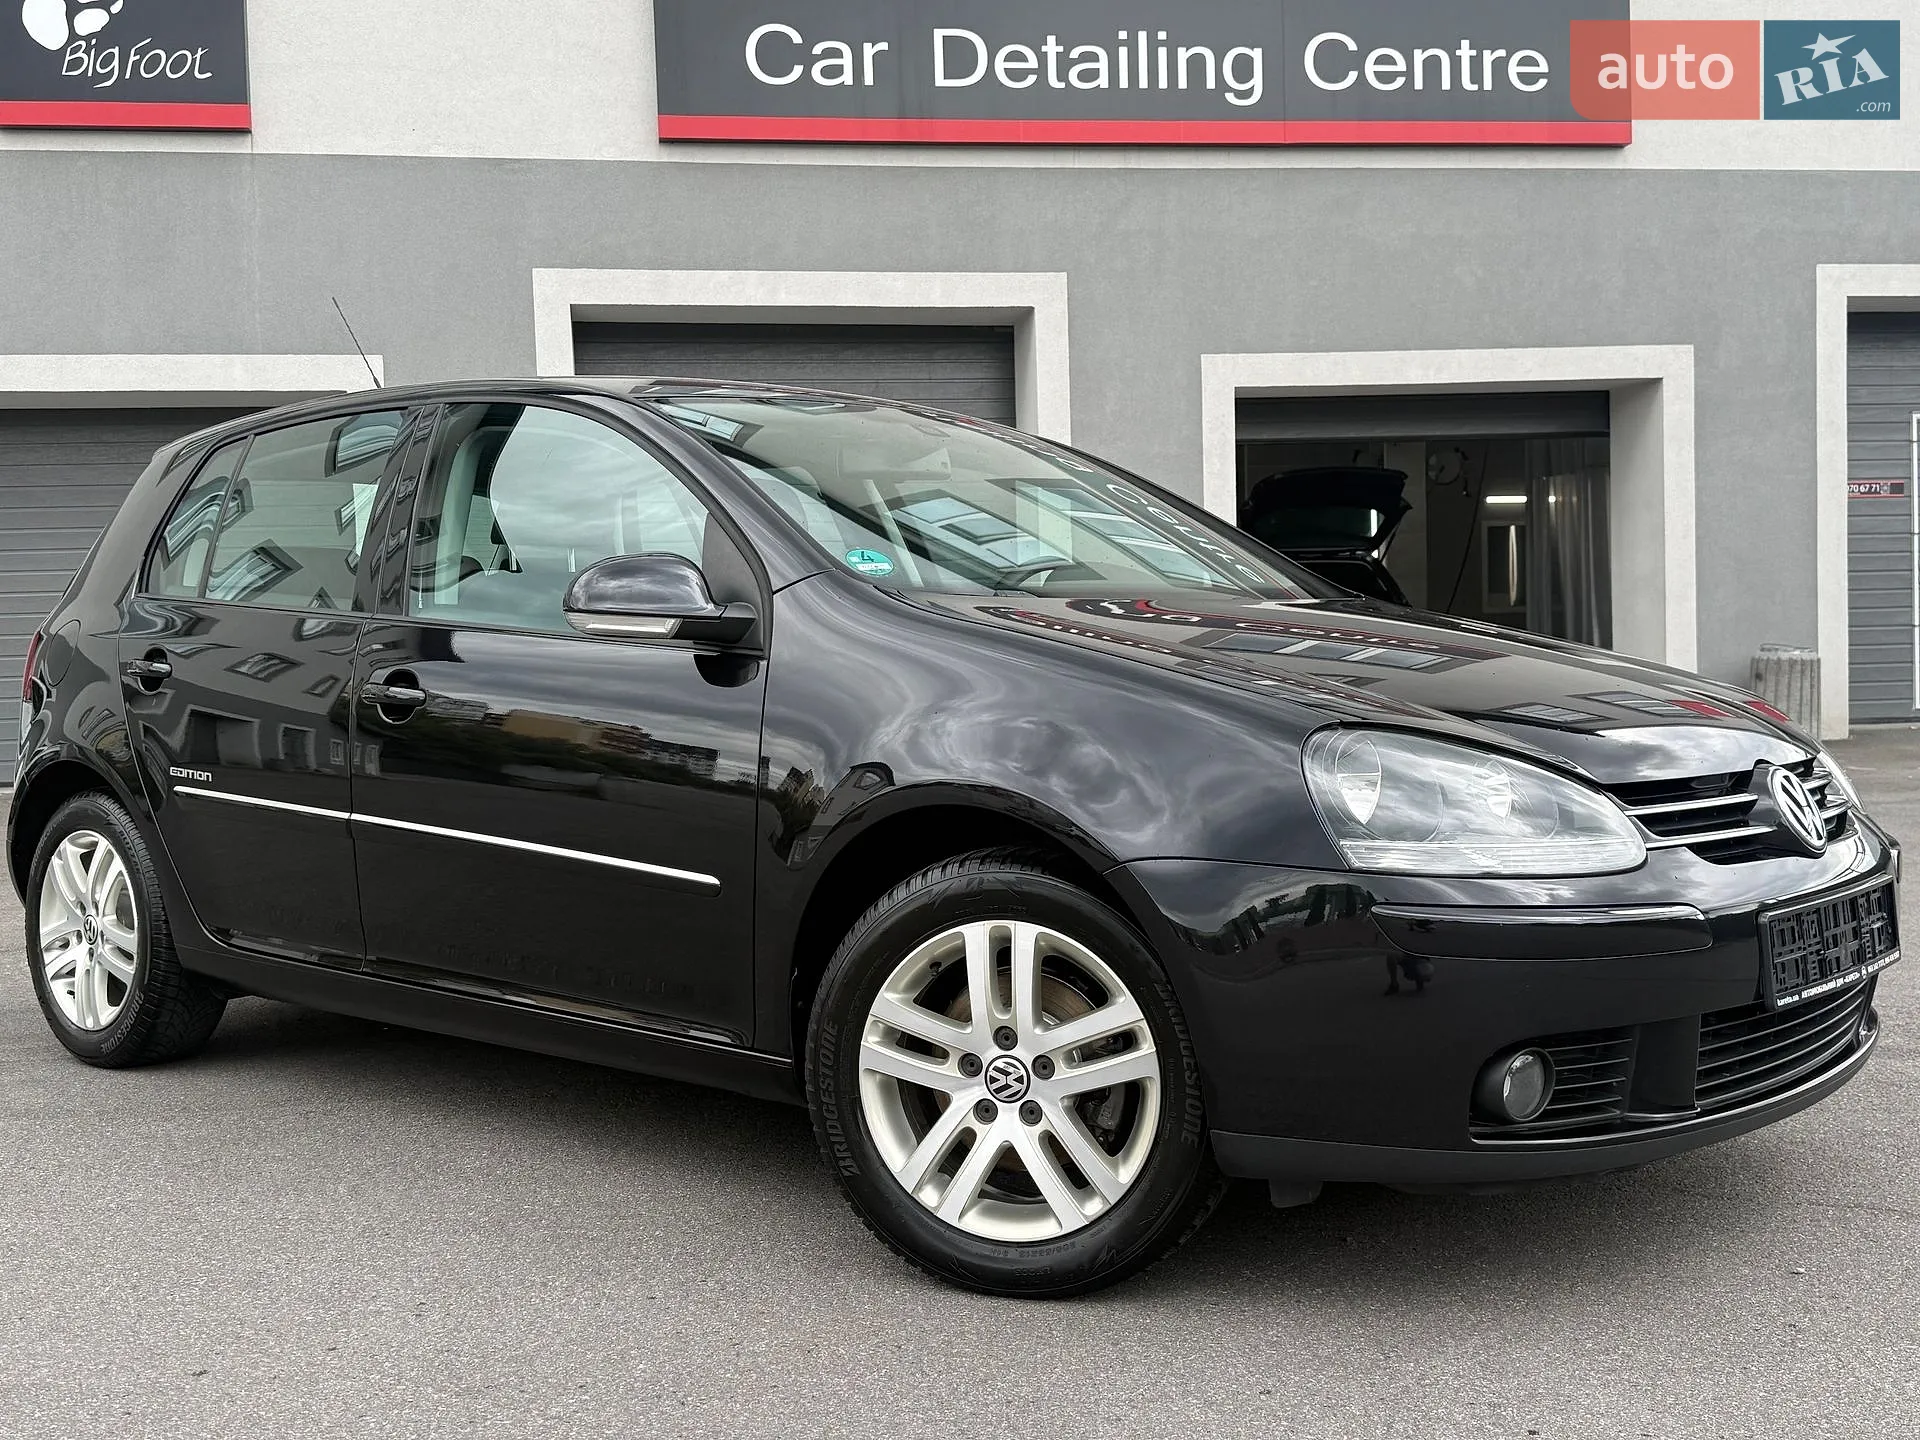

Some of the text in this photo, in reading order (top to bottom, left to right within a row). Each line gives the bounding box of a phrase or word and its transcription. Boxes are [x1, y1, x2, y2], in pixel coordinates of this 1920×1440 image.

[744, 23, 1549, 107] Car Detailing Centre
[170, 766, 213, 782] EDITION
[818, 1019, 862, 1177] BRIDGESTONE
